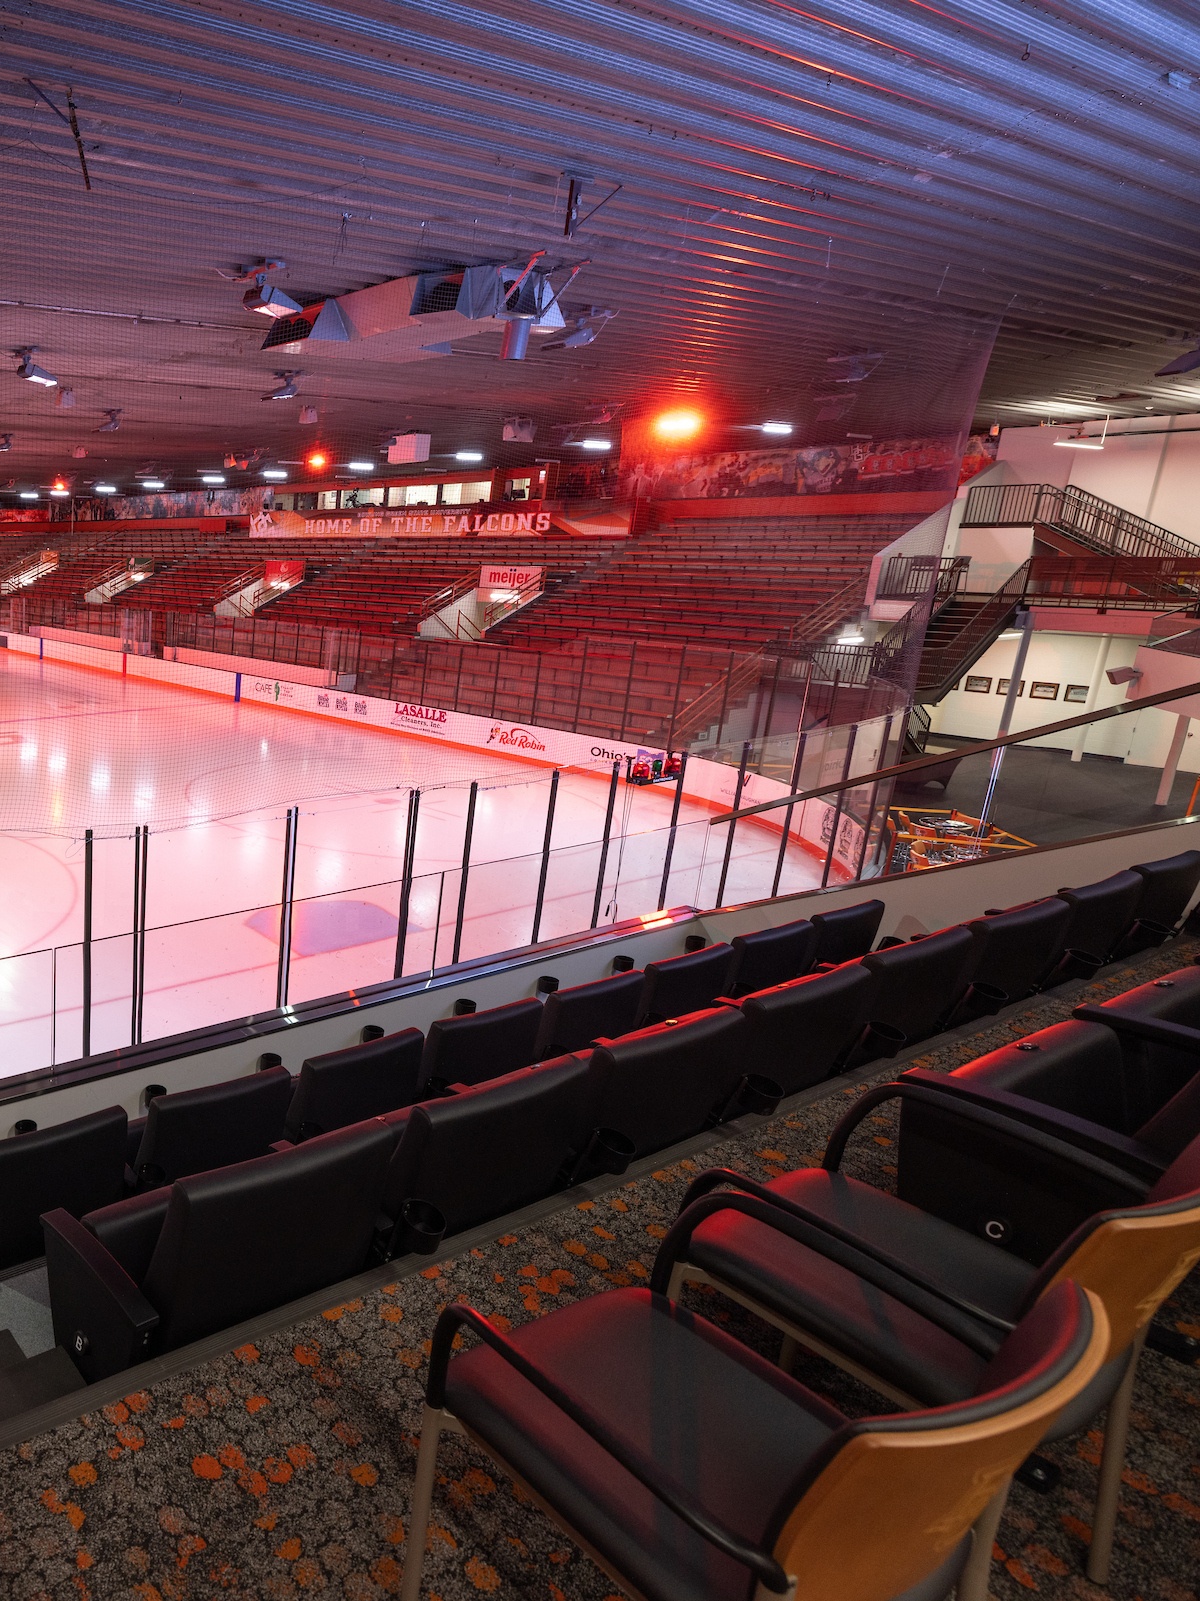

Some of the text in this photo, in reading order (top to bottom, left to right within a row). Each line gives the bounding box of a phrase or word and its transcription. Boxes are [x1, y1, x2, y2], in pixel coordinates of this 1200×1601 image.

[357, 510, 384, 518] BOWLING
[385, 509, 407, 517] GREEN
[430, 508, 471, 516] UNIVERSITY
[304, 512, 551, 535] HOME OF THE FALCONS
[489, 568, 531, 587] meijer
[255, 682, 273, 694] CAFE
[394, 703, 447, 723] LASALLE
[430, 720, 443, 729] Inc.
[499, 731, 546, 752] Red Robin
[720, 787, 736, 797] WILLIA
[985, 1220, 1005, 1239] C
[75, 1336, 83, 1352] B
